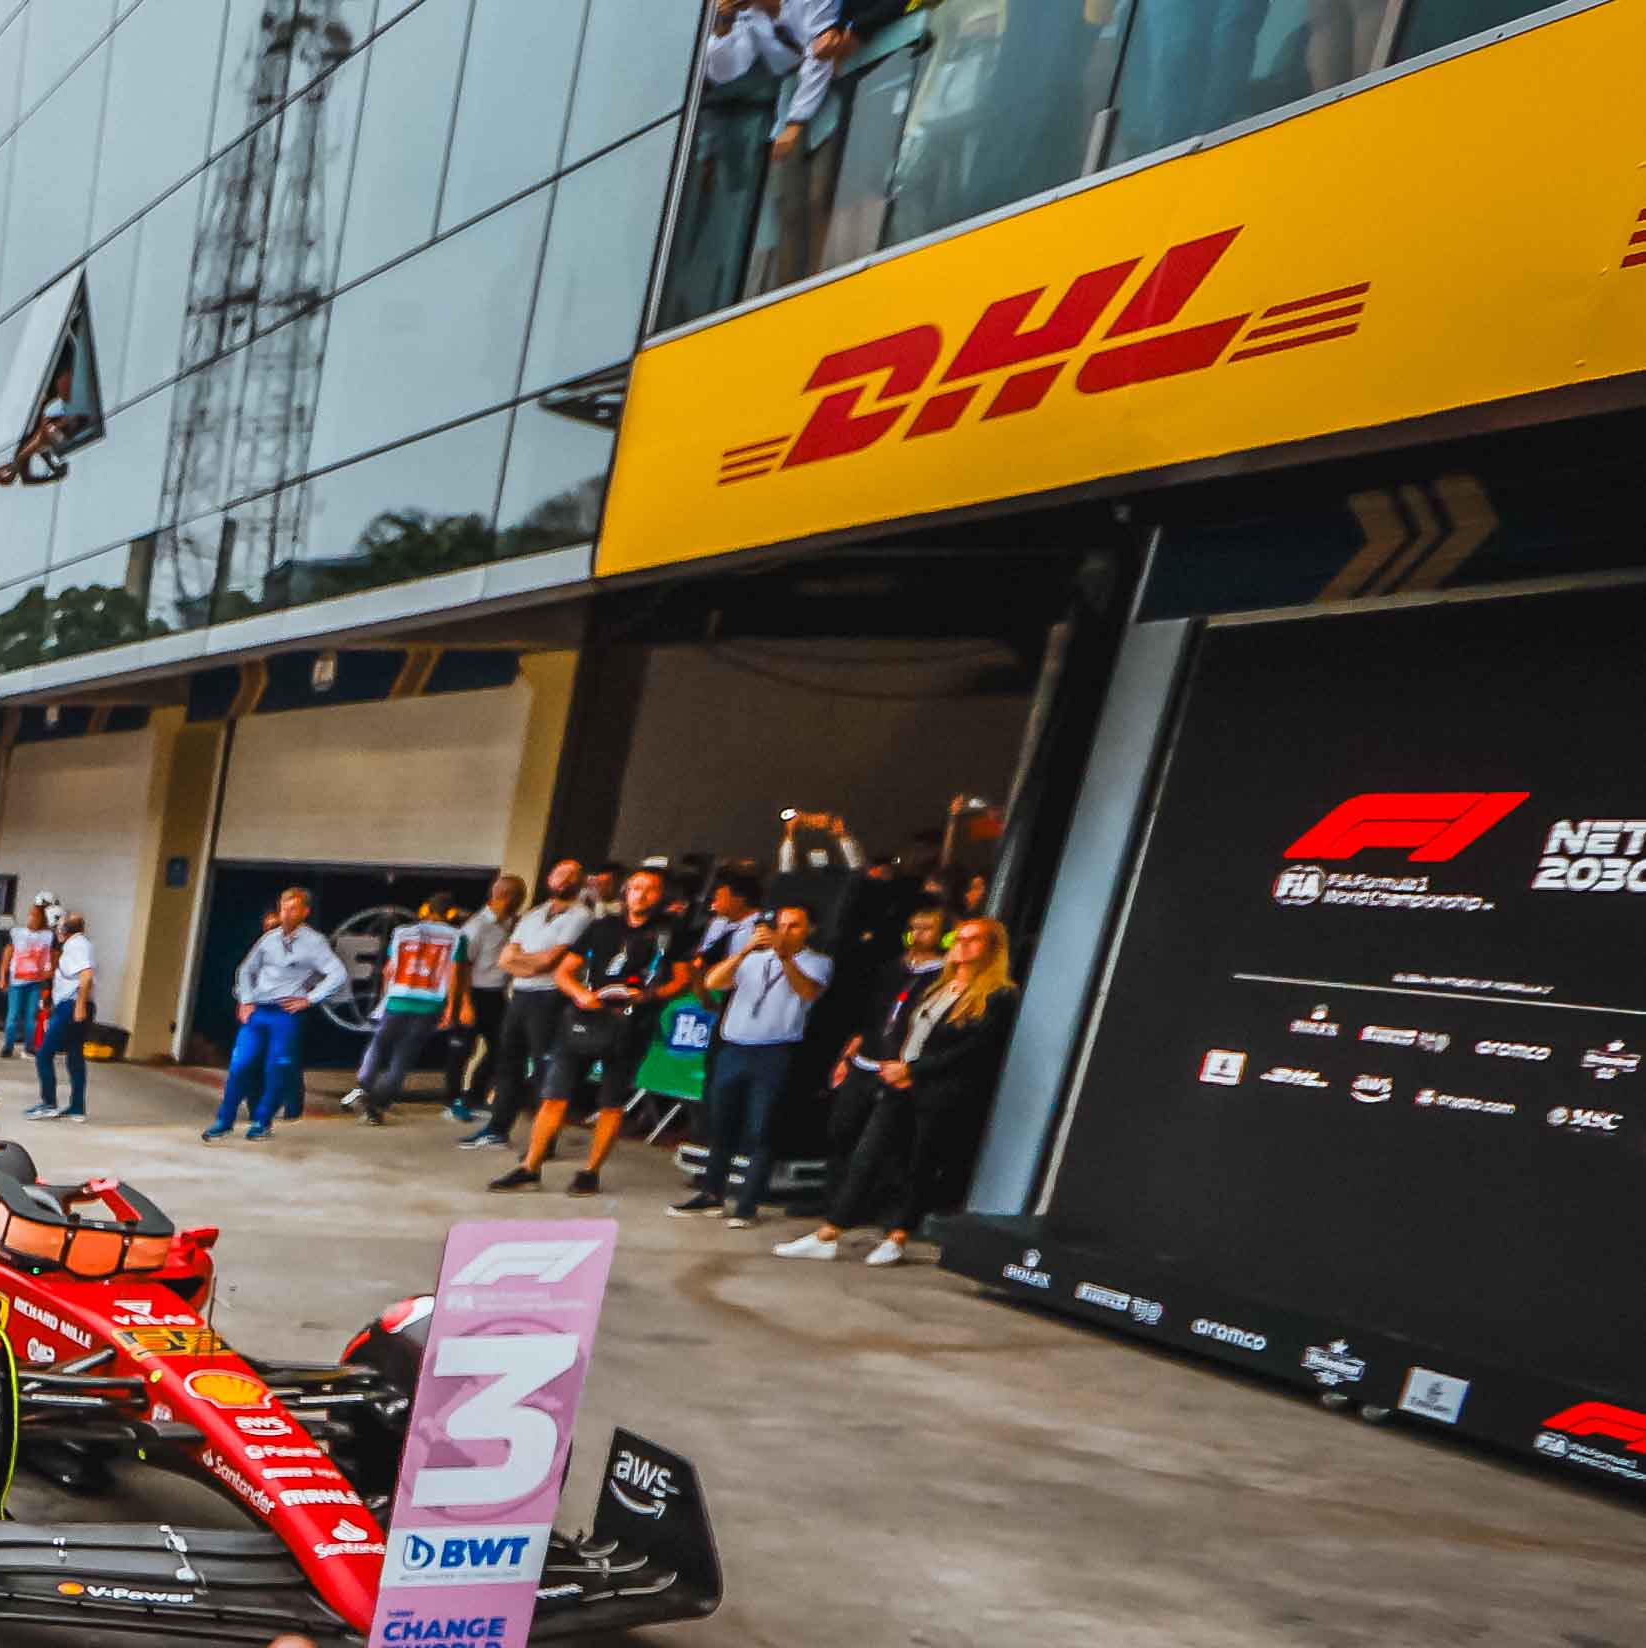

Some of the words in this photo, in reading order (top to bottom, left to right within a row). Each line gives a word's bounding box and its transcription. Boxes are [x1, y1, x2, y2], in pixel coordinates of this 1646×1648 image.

[783, 225, 1250, 467] DHL
[1283, 792, 1530, 862] F1
[1542, 819, 1646, 855] NET
[14, 1296, 58, 1331] RICHARD
[61, 1321, 92, 1349] MILLE
[1191, 1318, 1267, 1350] aramco
[412, 1334, 580, 1509] 3
[214, 1455, 276, 1515] Santander
[614, 1449, 673, 1498] aws
[440, 1537, 530, 1569] BWT
[383, 1617, 507, 1641] CHANGE
